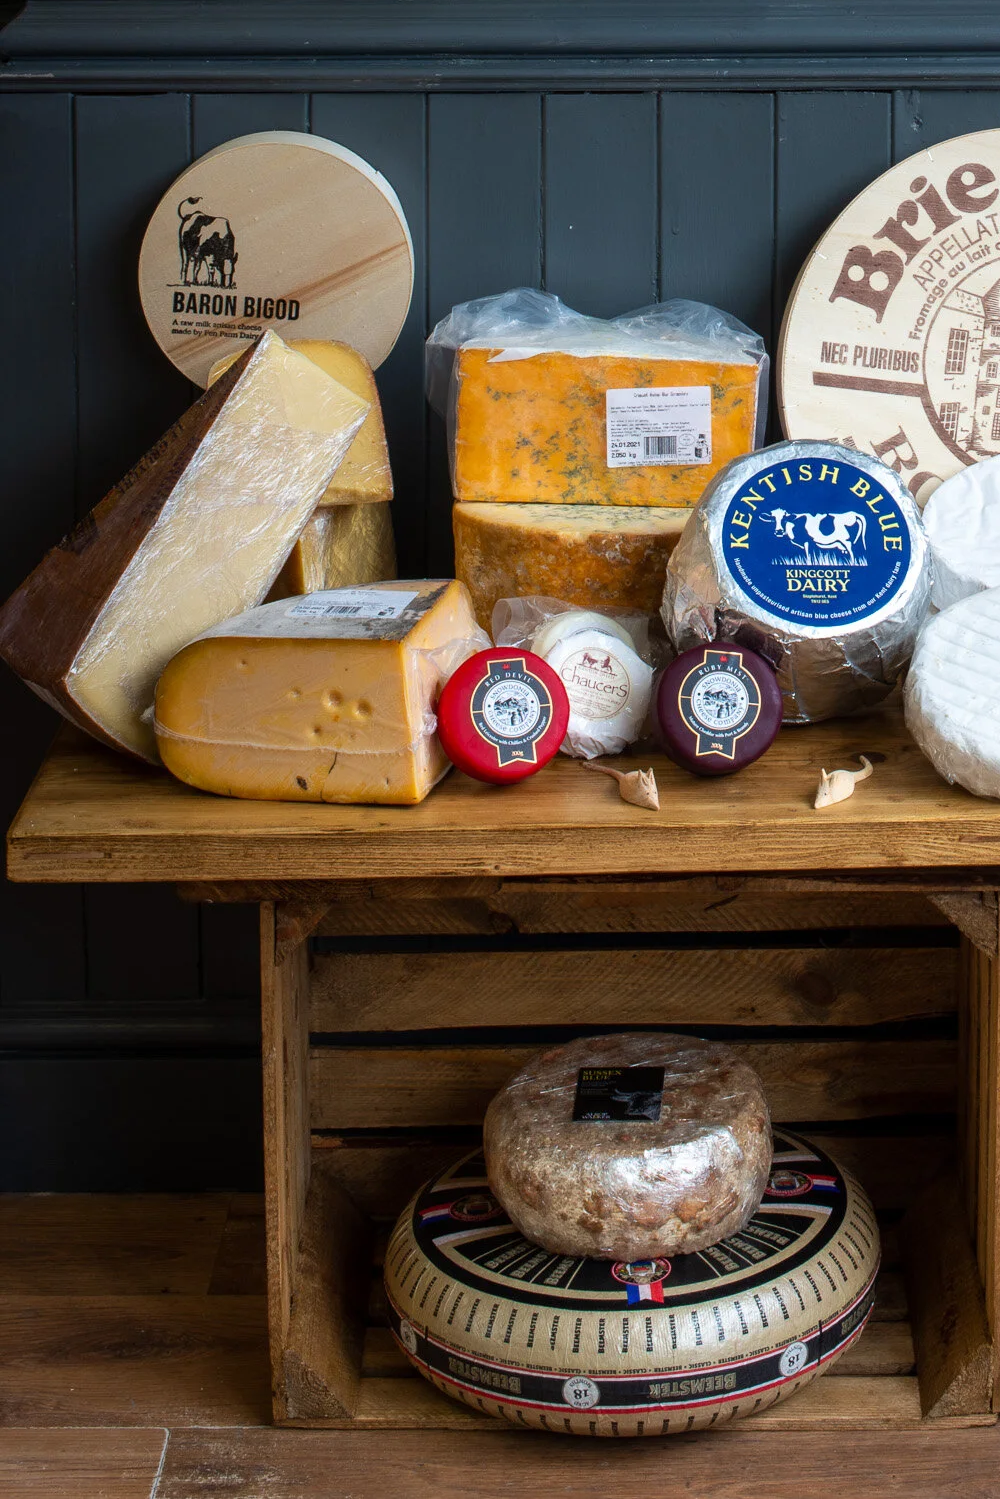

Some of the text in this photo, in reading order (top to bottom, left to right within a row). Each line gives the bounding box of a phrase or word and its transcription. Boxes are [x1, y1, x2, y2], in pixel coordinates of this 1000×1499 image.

[828, 163, 999, 324] Brie
[172, 292, 300, 321] BARON BIGOD
[908, 278, 949, 340] Fromage
[948, 261, 966, 278] au
[965, 245, 990, 264] lait
[820, 341, 920, 374] NEC PLURIBUS
[730, 464, 902, 552] KENTISH BLUE
[733, 557, 752, 586] Handmade
[751, 585, 789, 612] unpasteurised
[790, 610, 813, 618] artisan
[830, 609, 852, 619] cheese
[852, 604, 866, 614] from
[866, 598, 876, 607] our
[874, 587, 886, 601] Kent
[885, 574, 897, 590] dairy
[892, 560, 902, 575] farm
[786, 569, 850, 578] KINGCOTT
[787, 578, 851, 592] DAIRY
[485, 673, 531, 686] RED DEVIL
[698, 665, 747, 679] RUBY MIST
[449, 1357, 522, 1394] BEEMSTER
[648, 1373, 737, 1399] BEEMSTER
[573, 1388, 589, 1399] 18
